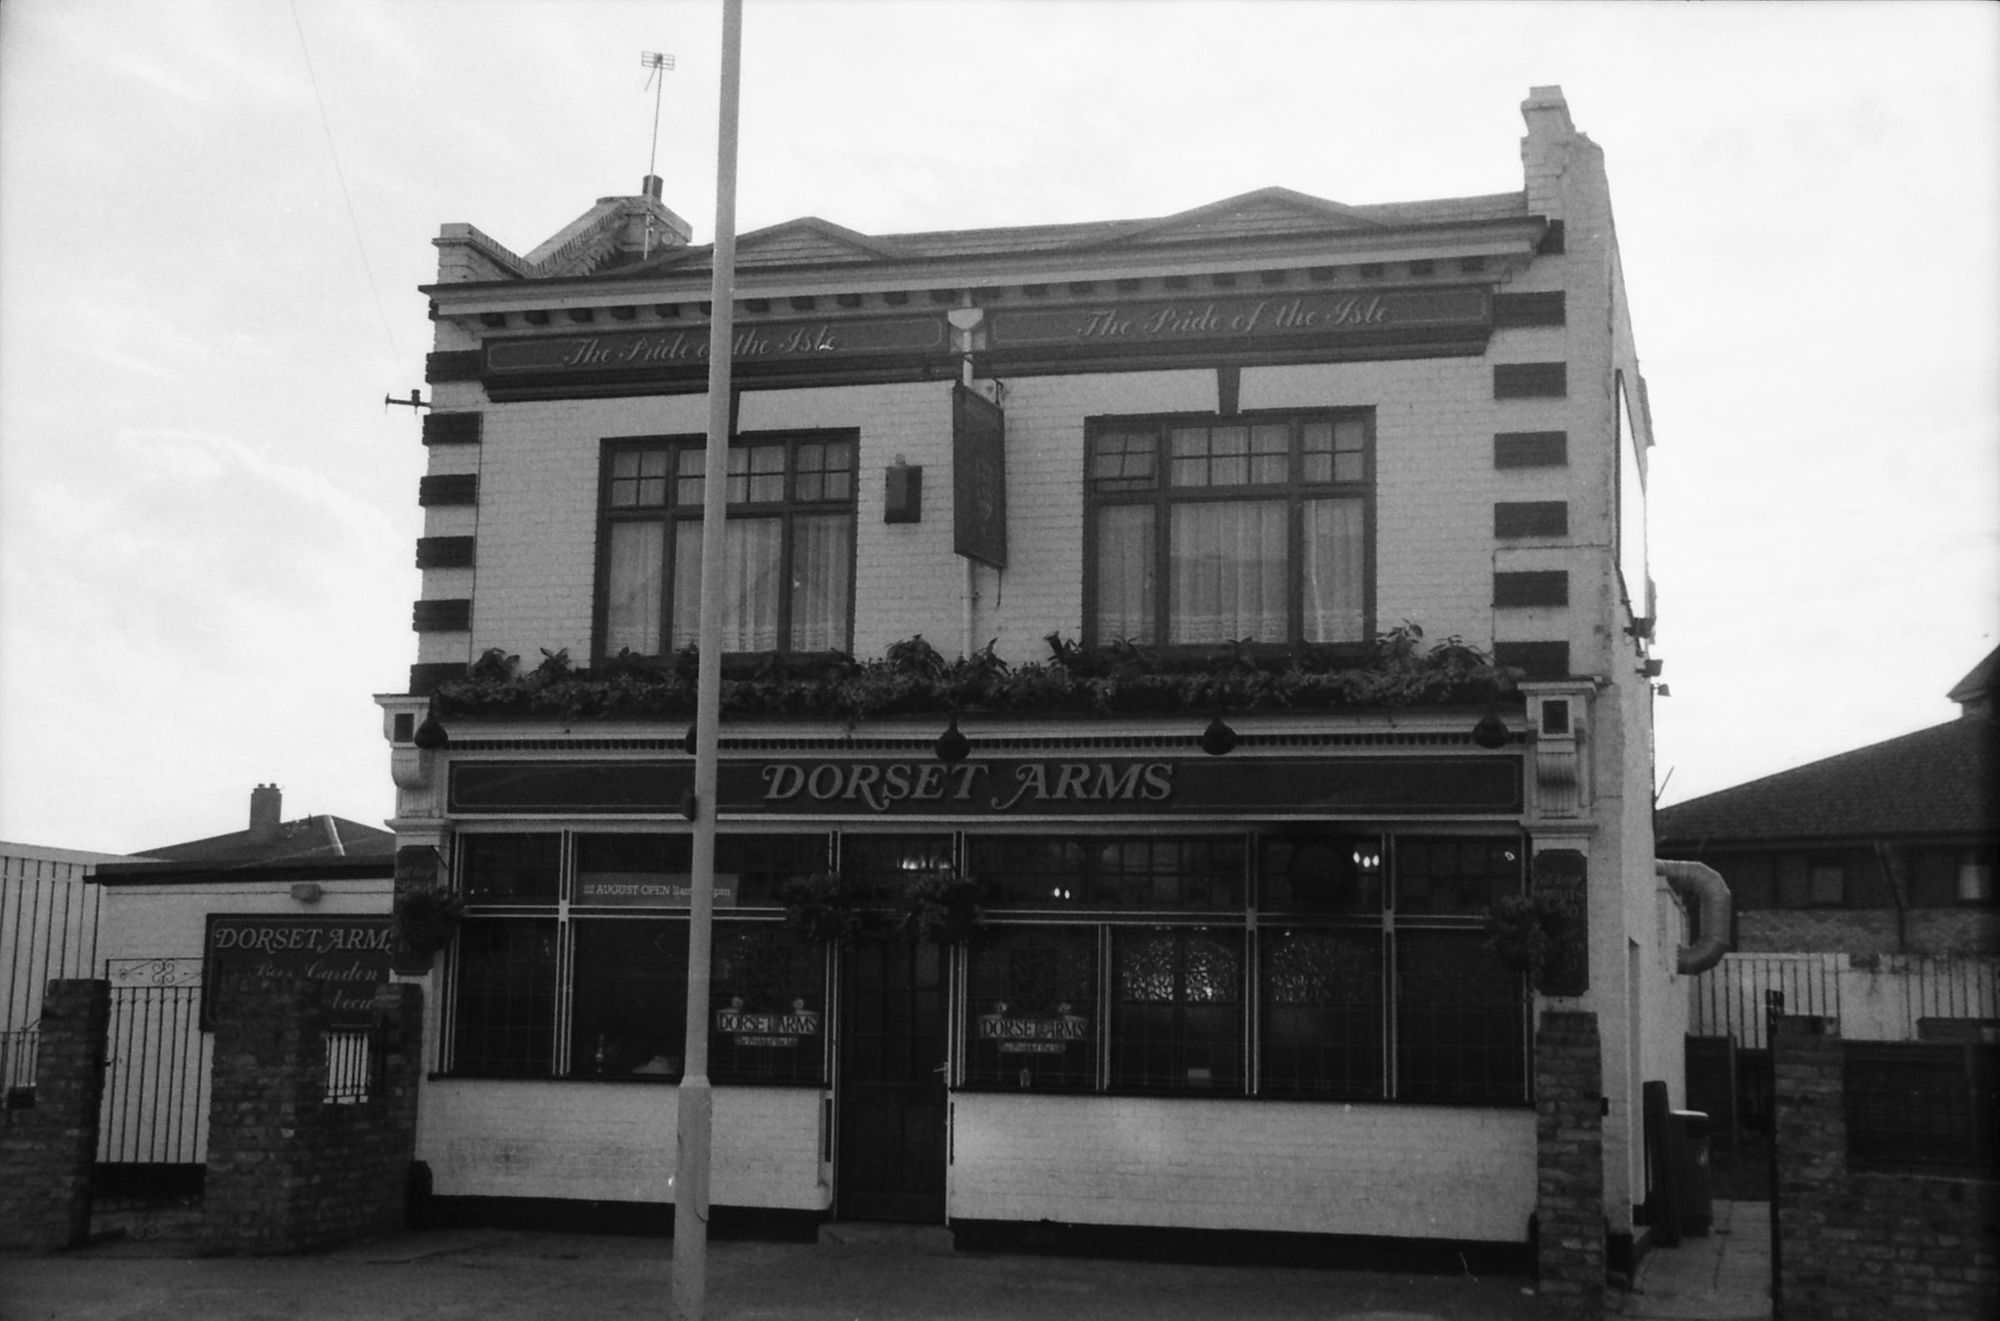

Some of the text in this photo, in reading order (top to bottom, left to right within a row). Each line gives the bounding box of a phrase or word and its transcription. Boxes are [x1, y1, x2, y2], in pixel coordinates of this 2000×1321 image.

[1077, 295, 1387, 336] The Pride of the Isle
[563, 337, 612, 366] The
[619, 333, 691, 361] Pride
[733, 329, 768, 356] the
[779, 324, 836, 353] Isle
[762, 762, 1174, 811] DORSET ARMS
[596, 884, 639, 896] AUGUST
[640, 884, 670, 896] OPEN
[215, 927, 324, 954] DORSET
[305, 960, 379, 982] Garden
[719, 1014, 816, 1034] DORSET ARMS
[983, 1019, 1085, 1039] DORSET ARMS
